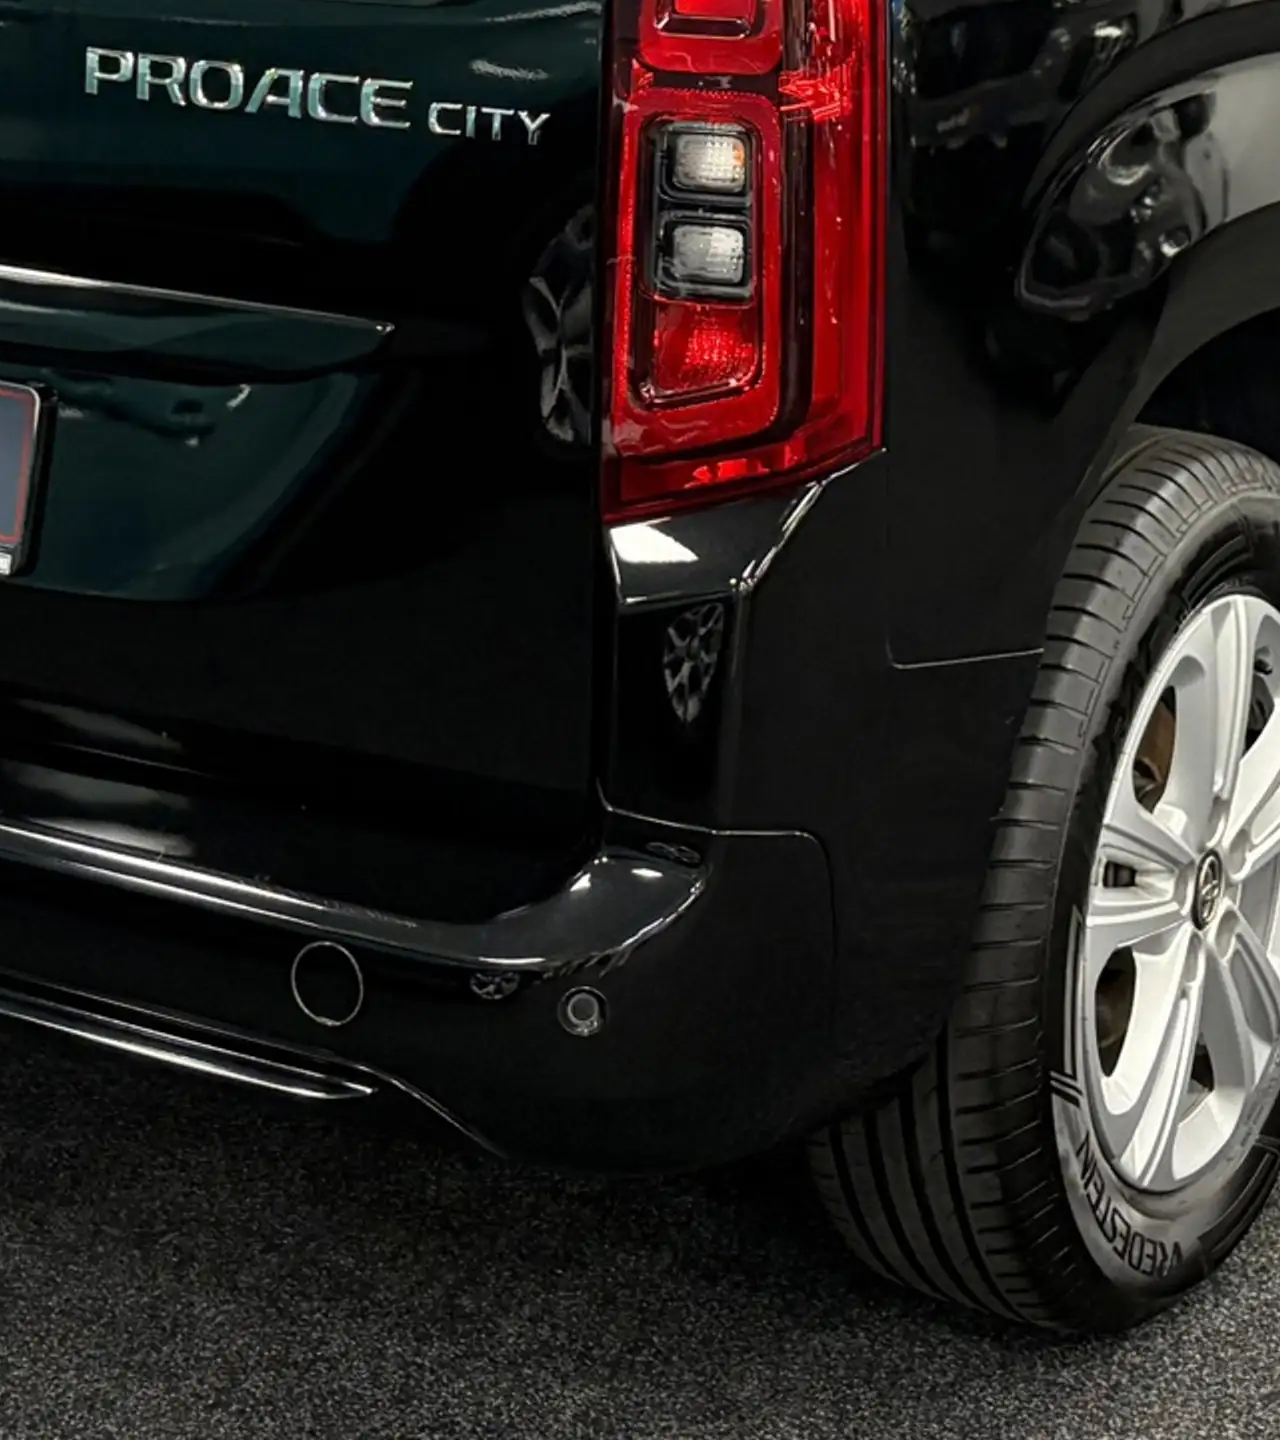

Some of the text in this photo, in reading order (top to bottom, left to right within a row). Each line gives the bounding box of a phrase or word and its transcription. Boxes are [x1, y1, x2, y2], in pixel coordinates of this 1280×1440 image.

[84, 45, 551, 145] PROACE CITY
[1075, 1130, 1184, 1281] VREDESTEIN
